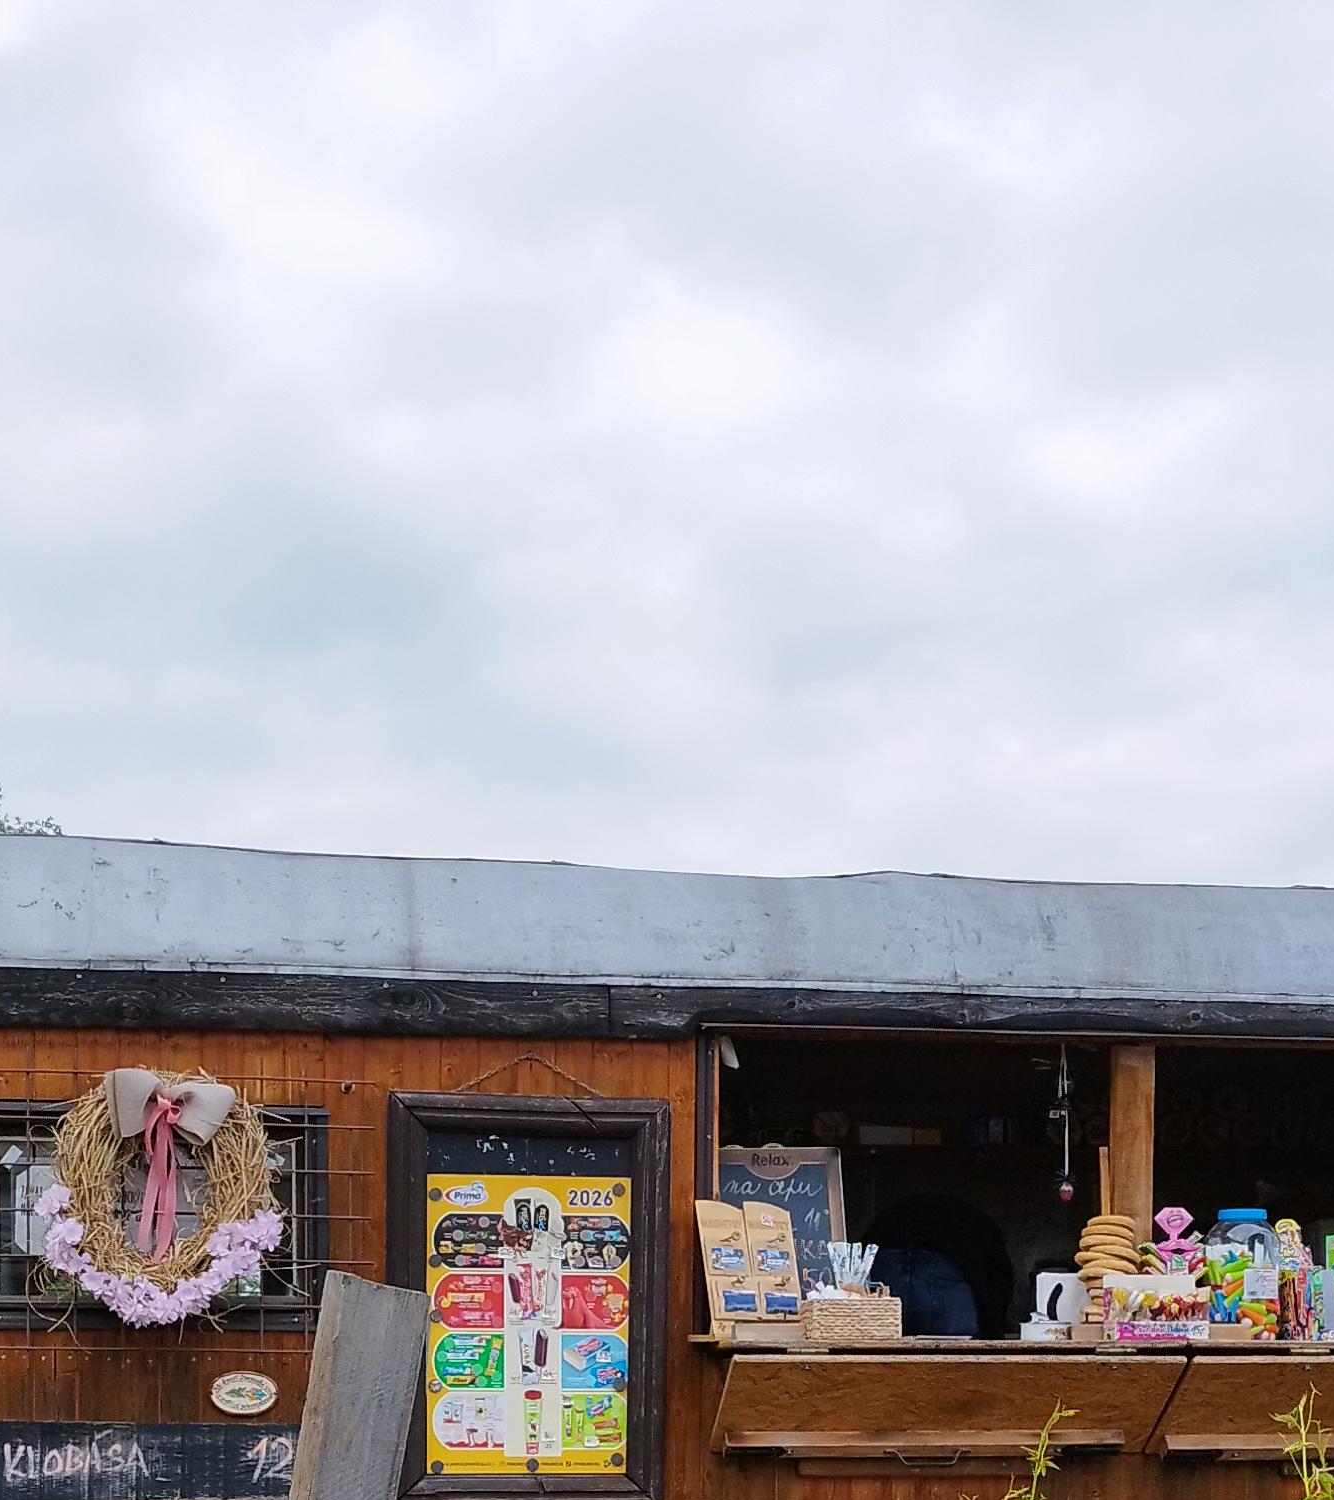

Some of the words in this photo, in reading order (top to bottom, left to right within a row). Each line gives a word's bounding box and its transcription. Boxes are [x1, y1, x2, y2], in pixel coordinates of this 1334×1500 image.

[724, 1180, 761, 1195] na
[454, 1191, 482, 1200] Prima
[568, 1189, 614, 1207] 2026
